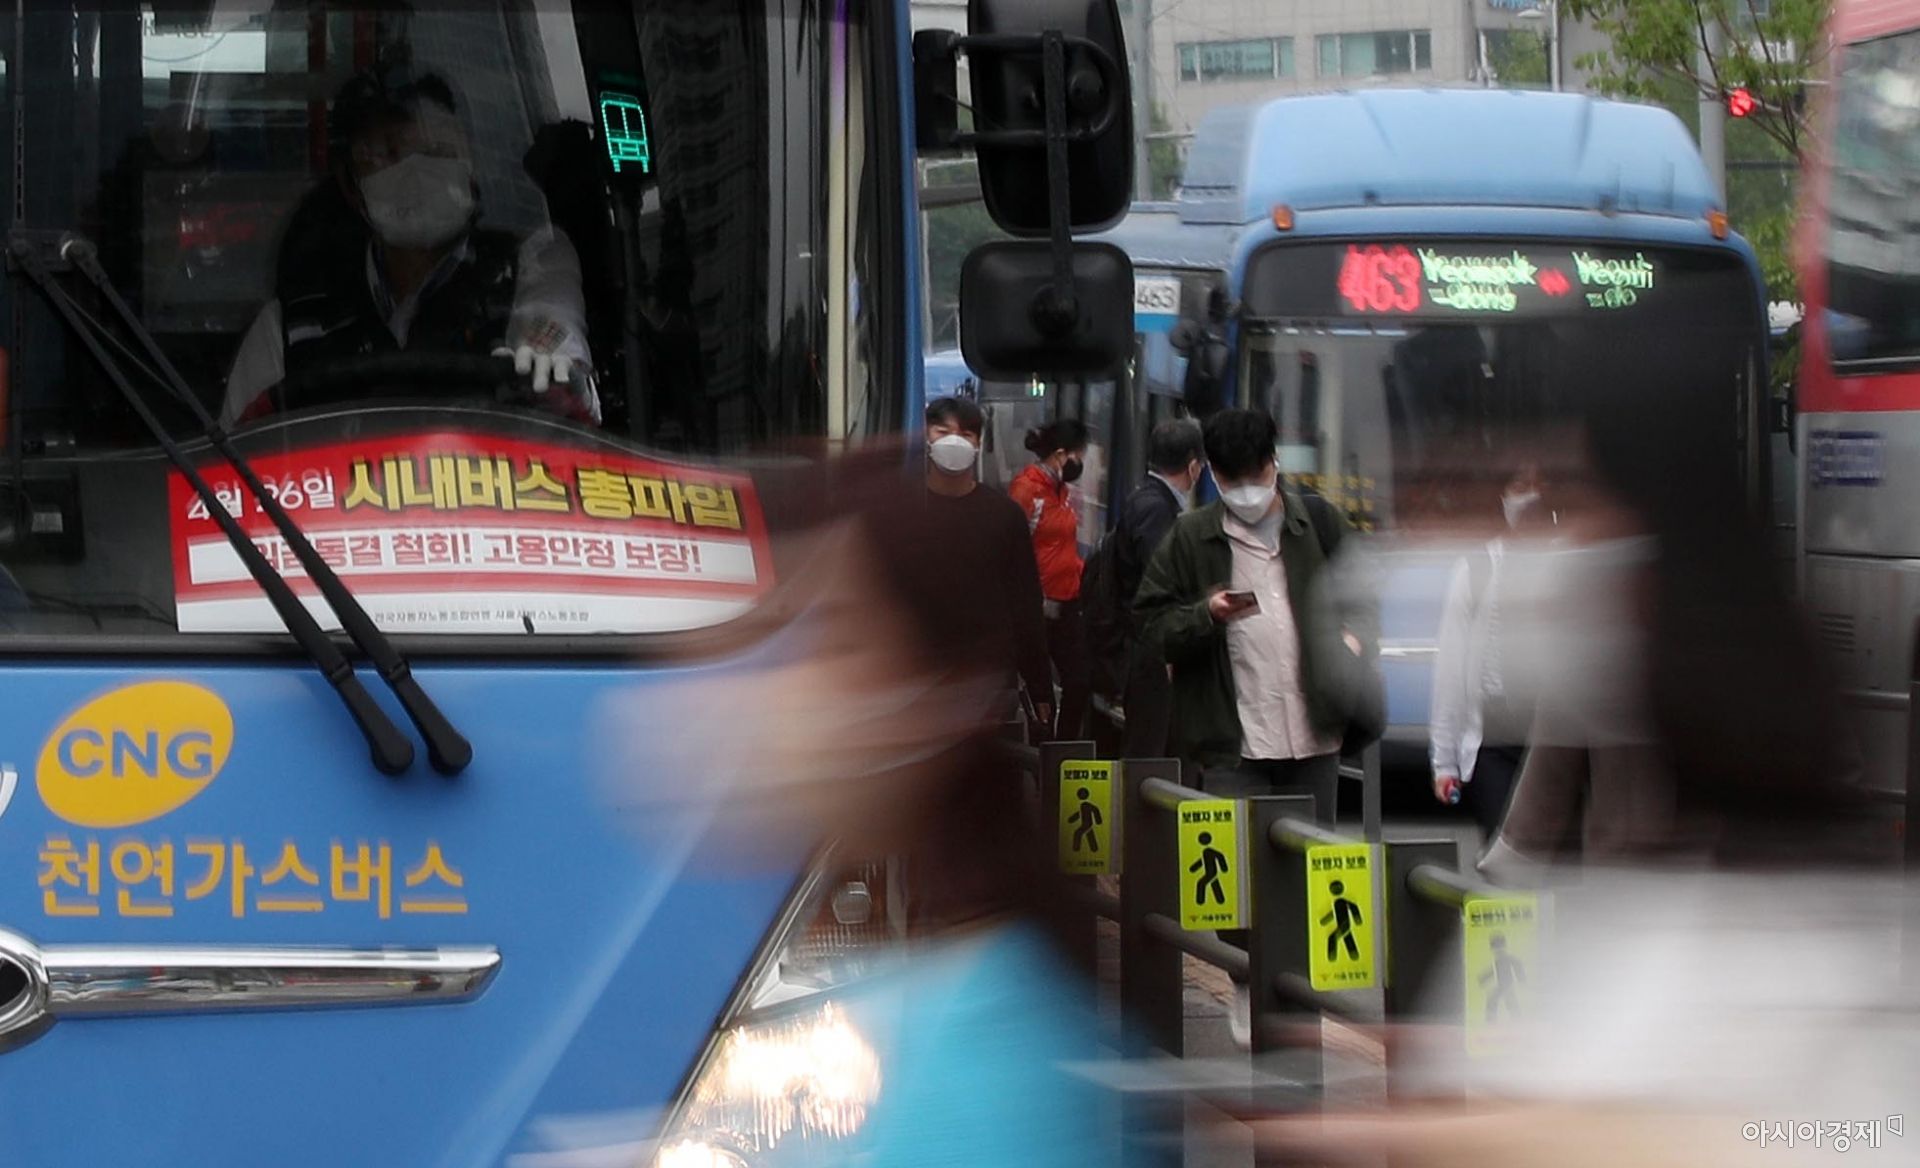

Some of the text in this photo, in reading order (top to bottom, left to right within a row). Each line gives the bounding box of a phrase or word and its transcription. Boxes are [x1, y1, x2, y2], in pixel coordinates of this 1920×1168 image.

[1337, 244, 1421, 312] 463
[344, 453, 570, 512] 시내버스
[576, 466, 743, 530] 총파업
[392, 532, 472, 566] 철회!
[483, 533, 616, 569] 고용안정
[624, 537, 703, 574] 보장!
[57, 728, 214, 778] CNG
[1182, 811, 1211, 823] 보행자
[37, 837, 469, 919] 천연가스버스
[1311, 857, 1342, 871] 보행자
